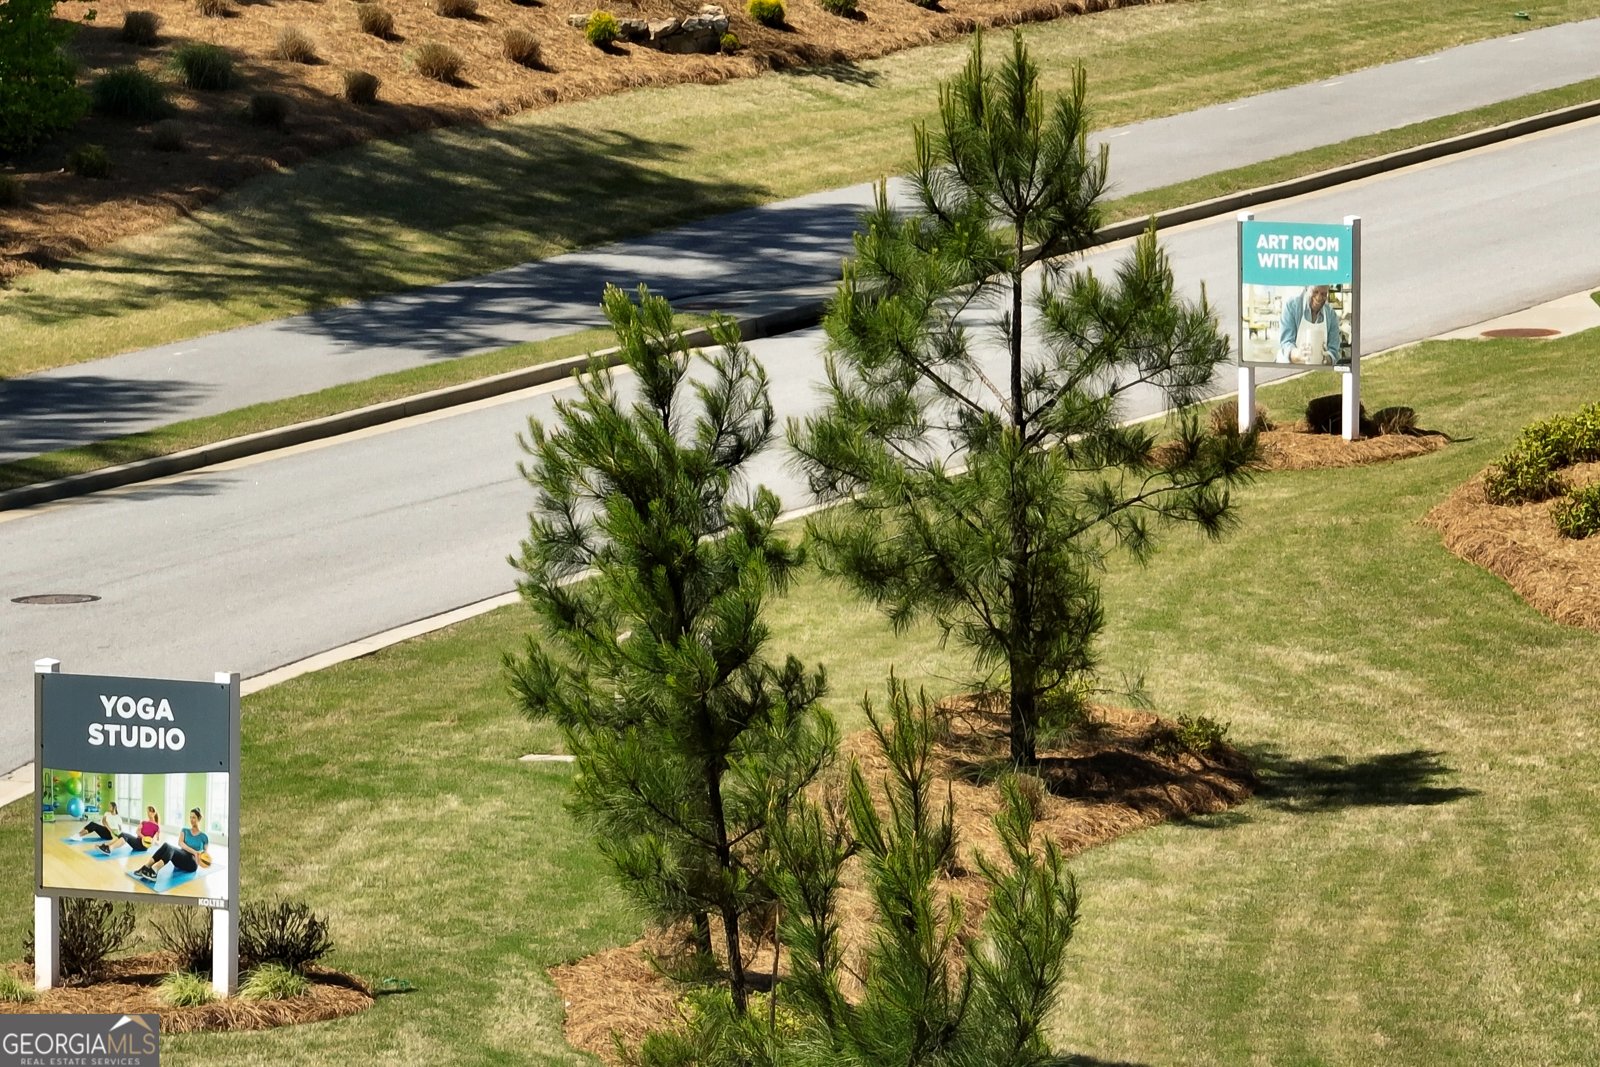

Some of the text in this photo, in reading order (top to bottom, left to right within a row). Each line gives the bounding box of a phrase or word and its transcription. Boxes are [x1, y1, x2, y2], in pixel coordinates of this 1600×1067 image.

[1256, 234, 1339, 252] ART ROOM
[1257, 253, 1338, 271] WITH KILN
[99, 695, 174, 721] YOGA
[88, 723, 185, 751] STUDIO
